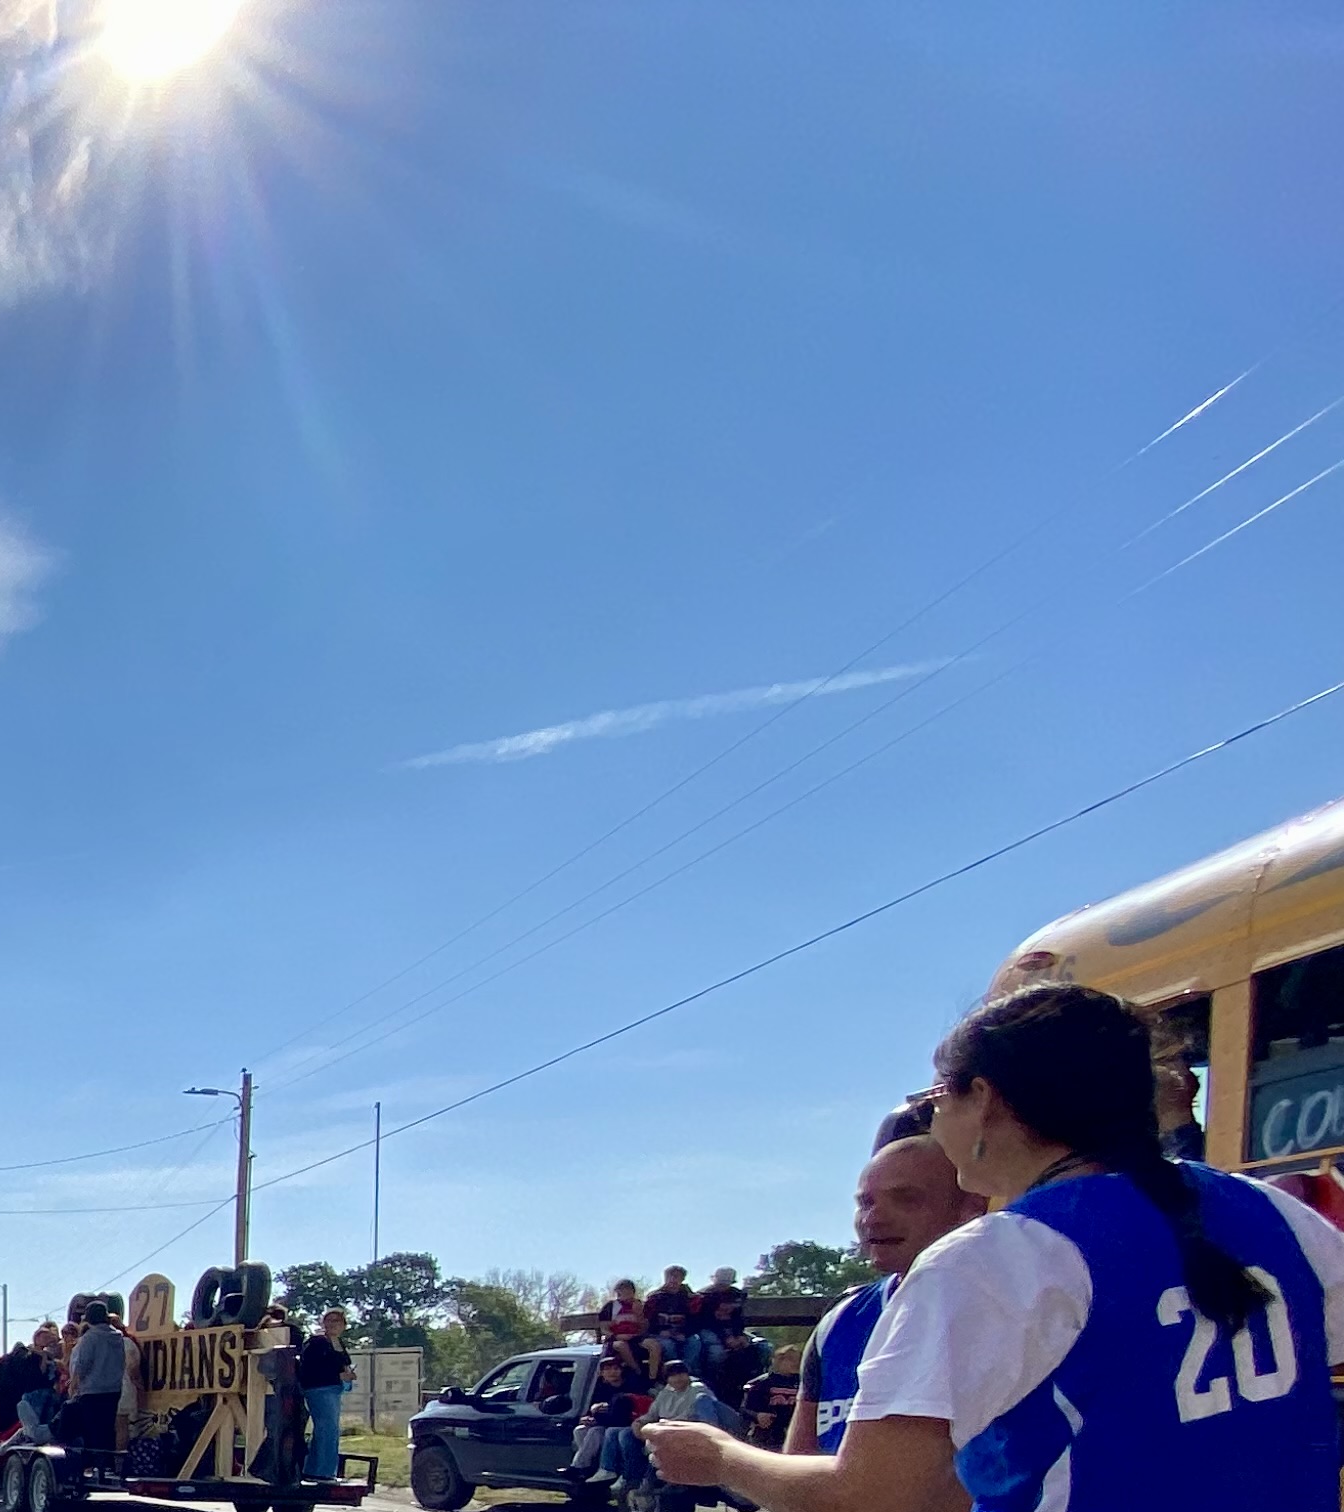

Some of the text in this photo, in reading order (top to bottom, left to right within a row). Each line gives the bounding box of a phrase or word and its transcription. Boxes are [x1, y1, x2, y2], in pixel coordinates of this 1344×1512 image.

[136, 1282, 170, 1332] 27
[140, 1330, 237, 1392] NDIANS
[1156, 1265, 1298, 1424] 20
